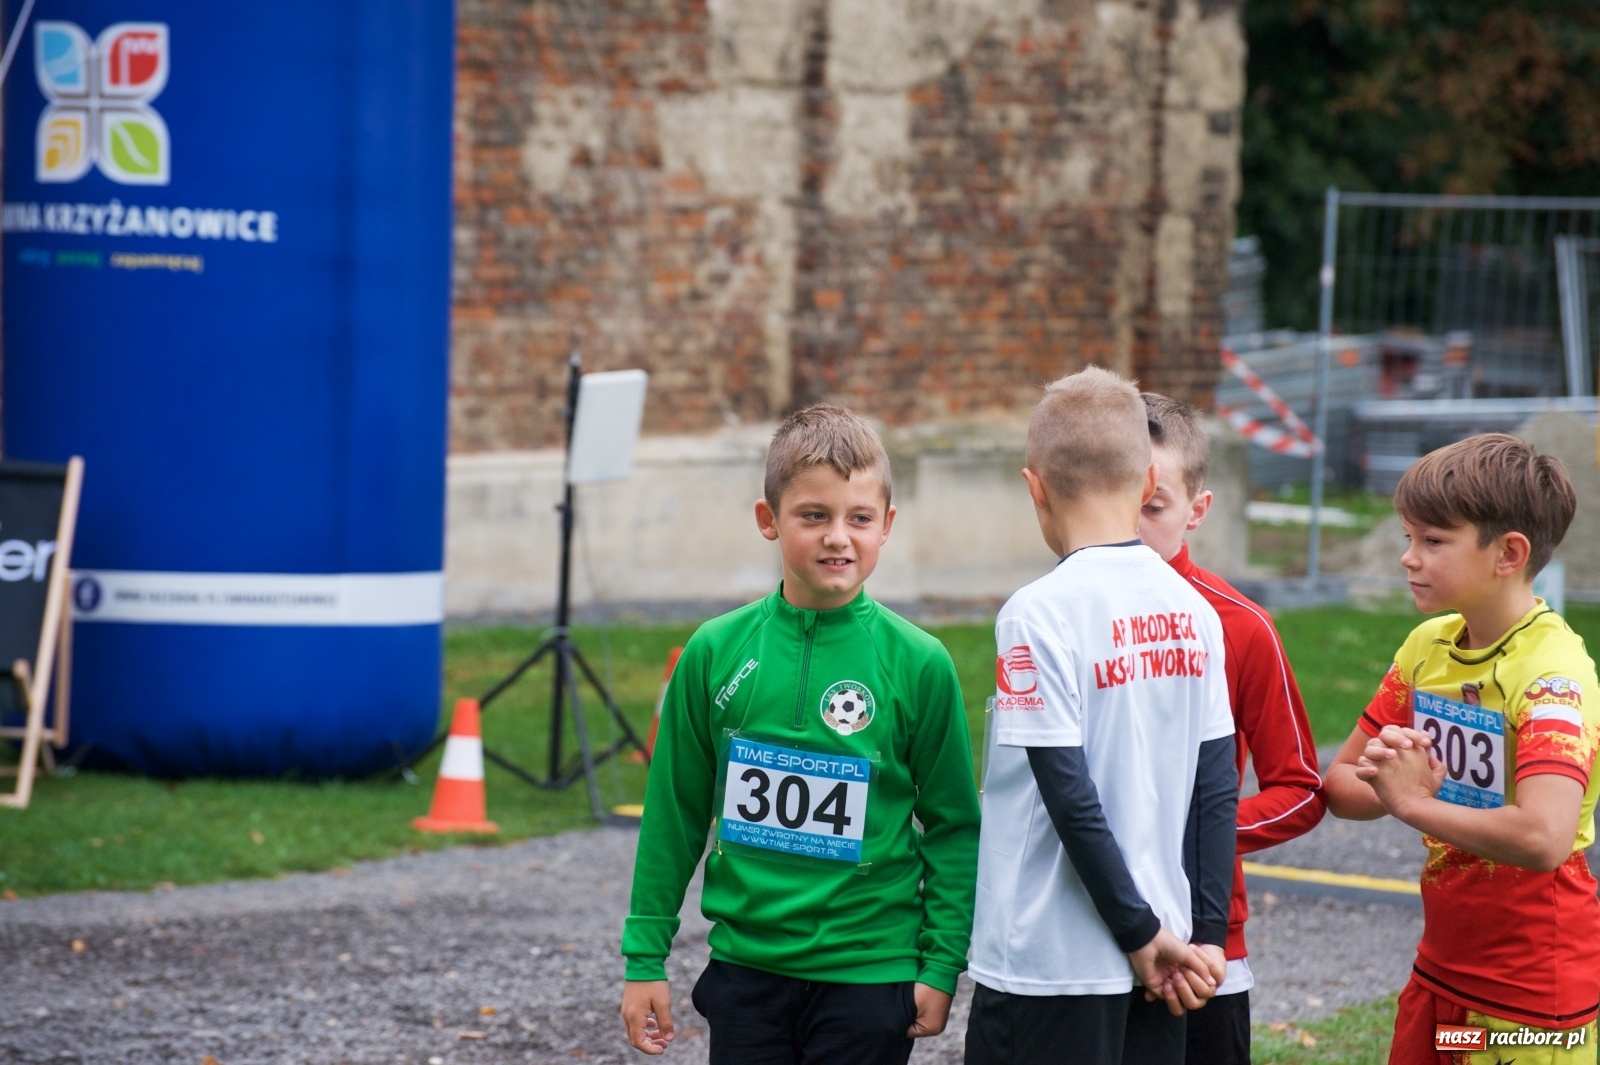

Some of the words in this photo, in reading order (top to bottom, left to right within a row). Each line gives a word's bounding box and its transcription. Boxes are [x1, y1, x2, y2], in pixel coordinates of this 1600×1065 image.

[997, 697, 1044, 706] KADEMIA
[1417, 695, 1501, 730] TIME-SPORT.PL
[1533, 698, 1580, 710] POLSKA
[735, 745, 865, 778] TIME-SPORT.PL
[737, 768, 851, 836] 304
[728, 822, 760, 835] NUMER
[762, 828, 809, 843] ZWROTNY
[811, 836, 825, 846] NA
[826, 840, 856, 850] MECIE
